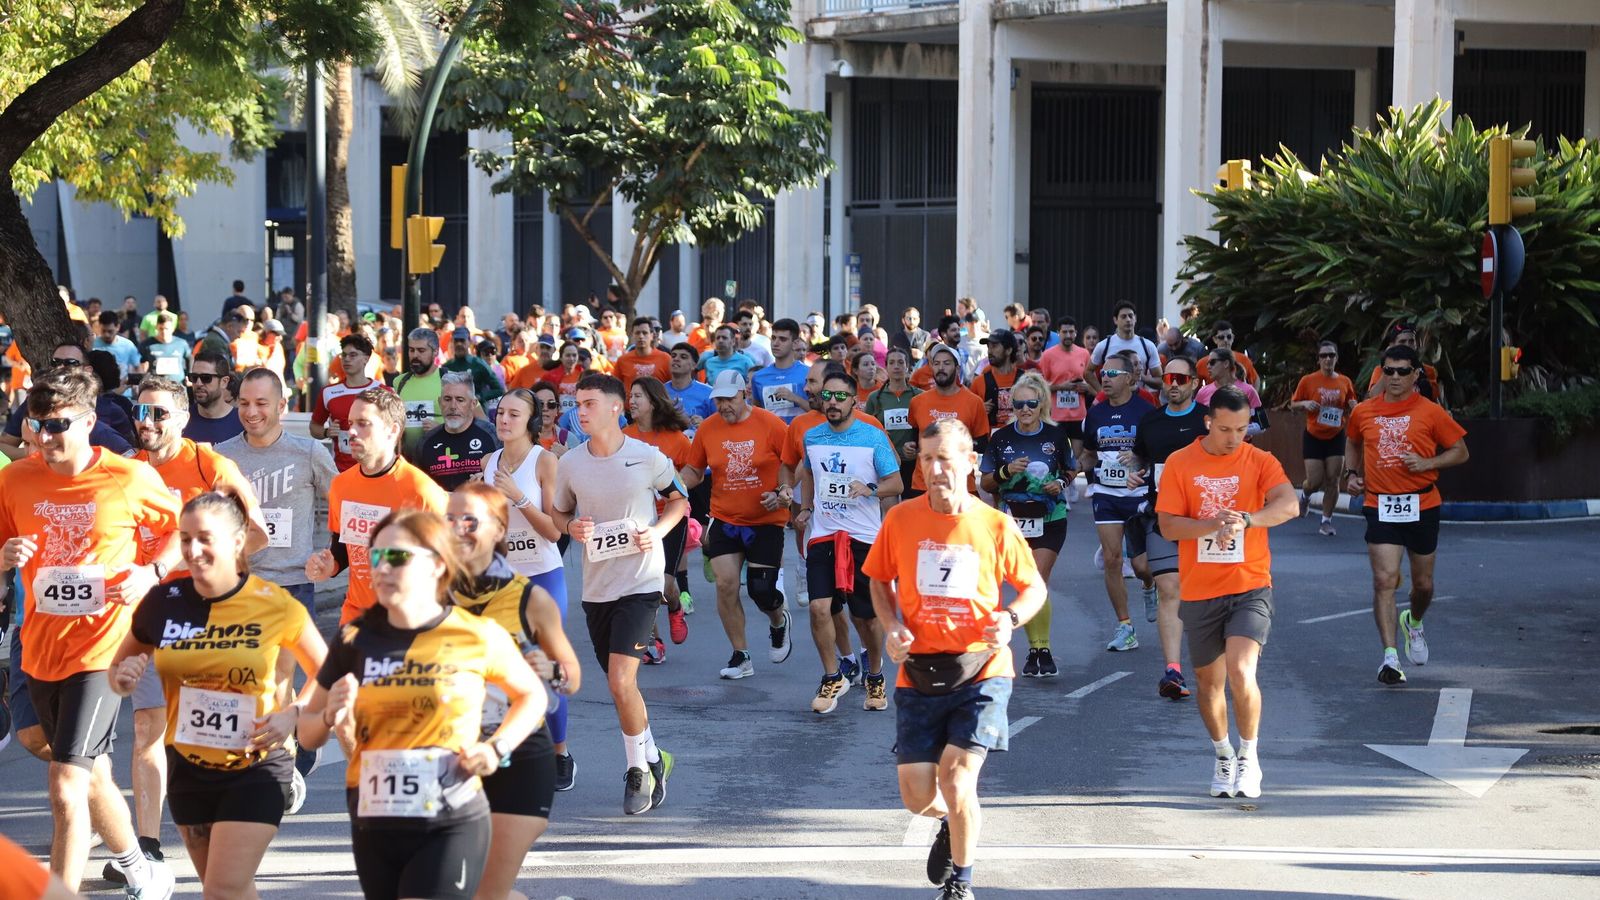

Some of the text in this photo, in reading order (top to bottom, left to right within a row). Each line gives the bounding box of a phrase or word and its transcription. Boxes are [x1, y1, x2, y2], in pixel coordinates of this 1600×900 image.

[1103, 468, 1126, 478] 180
[829, 483, 846, 495] 51
[1384, 504, 1412, 514] 794
[592, 532, 630, 551] 728
[1204, 538, 1236, 551] 73
[939, 567, 951, 582] 7
[44, 584, 93, 601] 493
[162, 618, 262, 641] bichos
[159, 638, 260, 650] runners
[363, 657, 459, 678] bichos
[361, 675, 456, 688] runners
[190, 709, 239, 732] 341
[368, 775, 420, 796] 115
